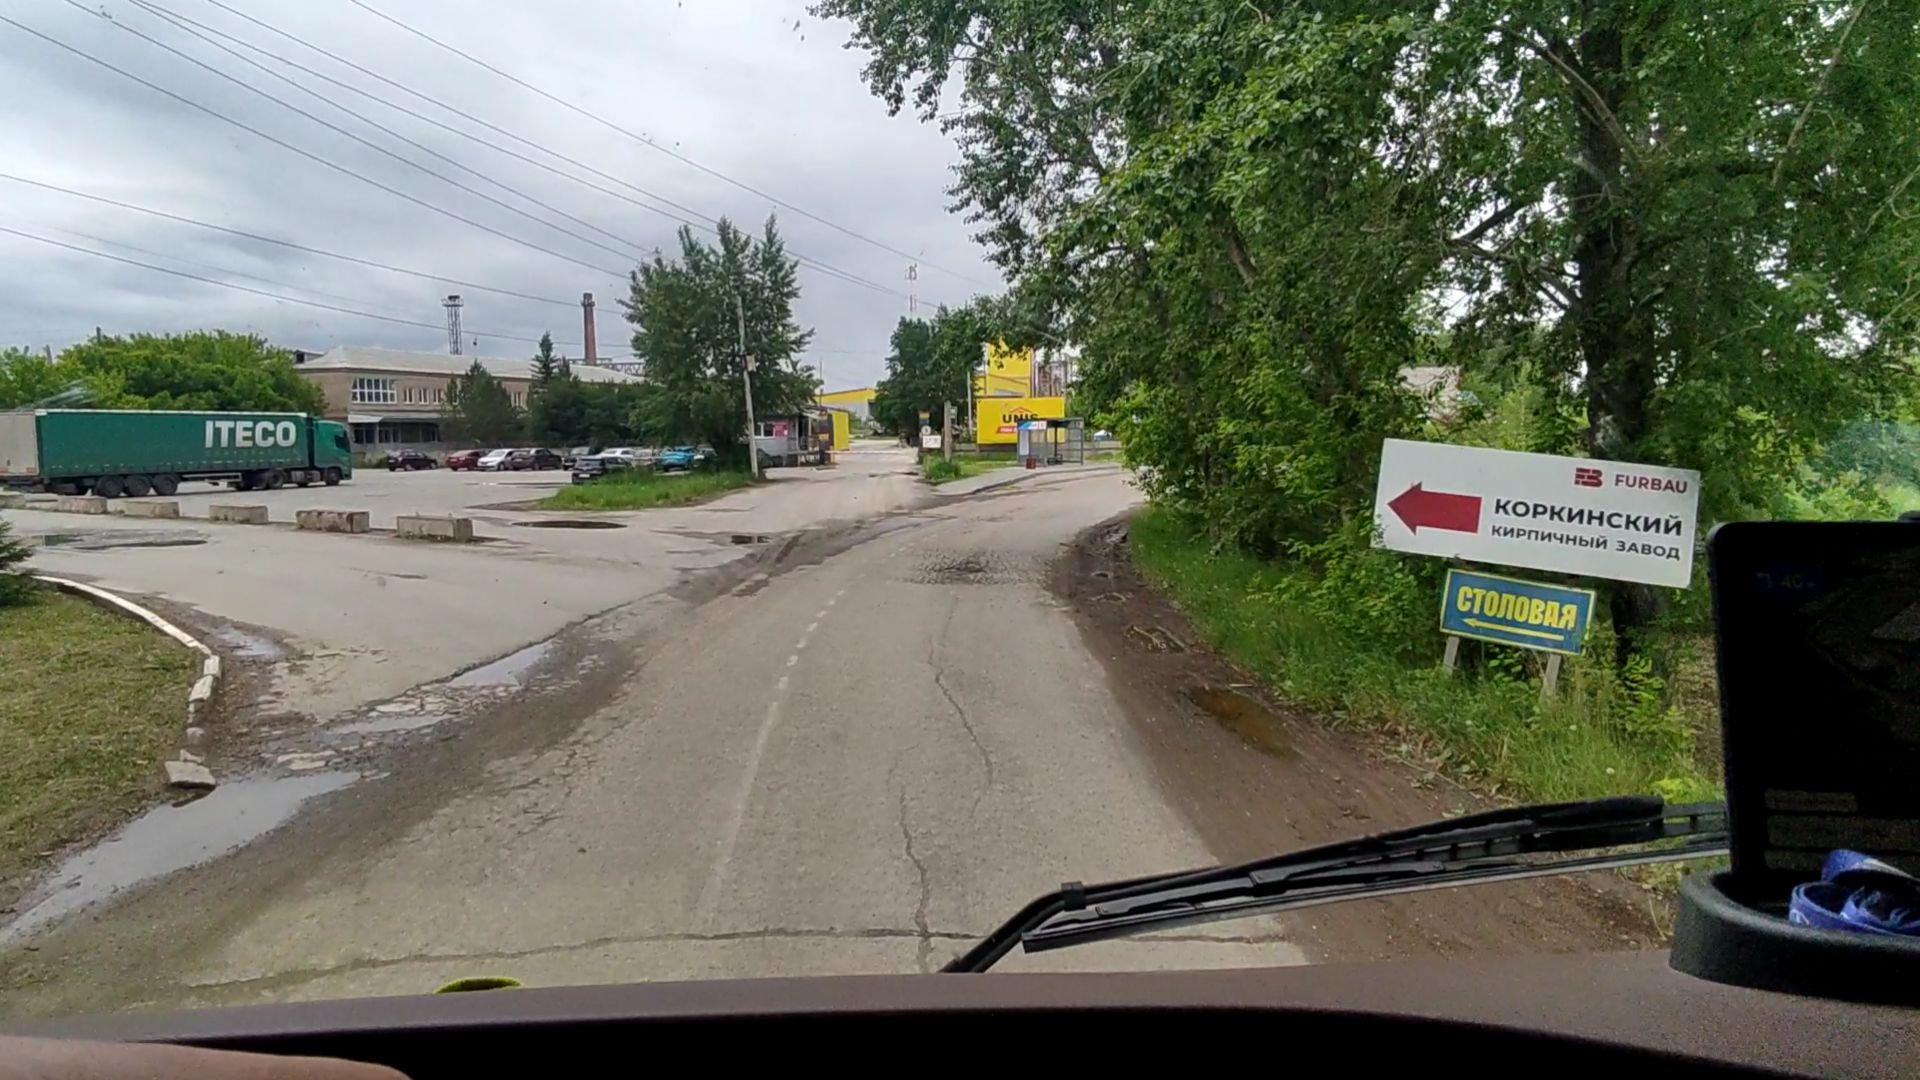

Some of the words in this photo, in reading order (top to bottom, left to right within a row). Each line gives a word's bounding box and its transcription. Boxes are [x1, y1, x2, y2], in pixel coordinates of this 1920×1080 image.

[205, 420, 297, 448] ITECO
[1614, 474, 1688, 494] FURBAU
[1494, 499, 1683, 536] КОРКИНСКИЙ
[1491, 525, 1608, 550] КИРПИЧНЫЙ
[1615, 540, 1680, 561] ЗАВОД
[1456, 585, 1578, 630] СТОЛОВАЯ
